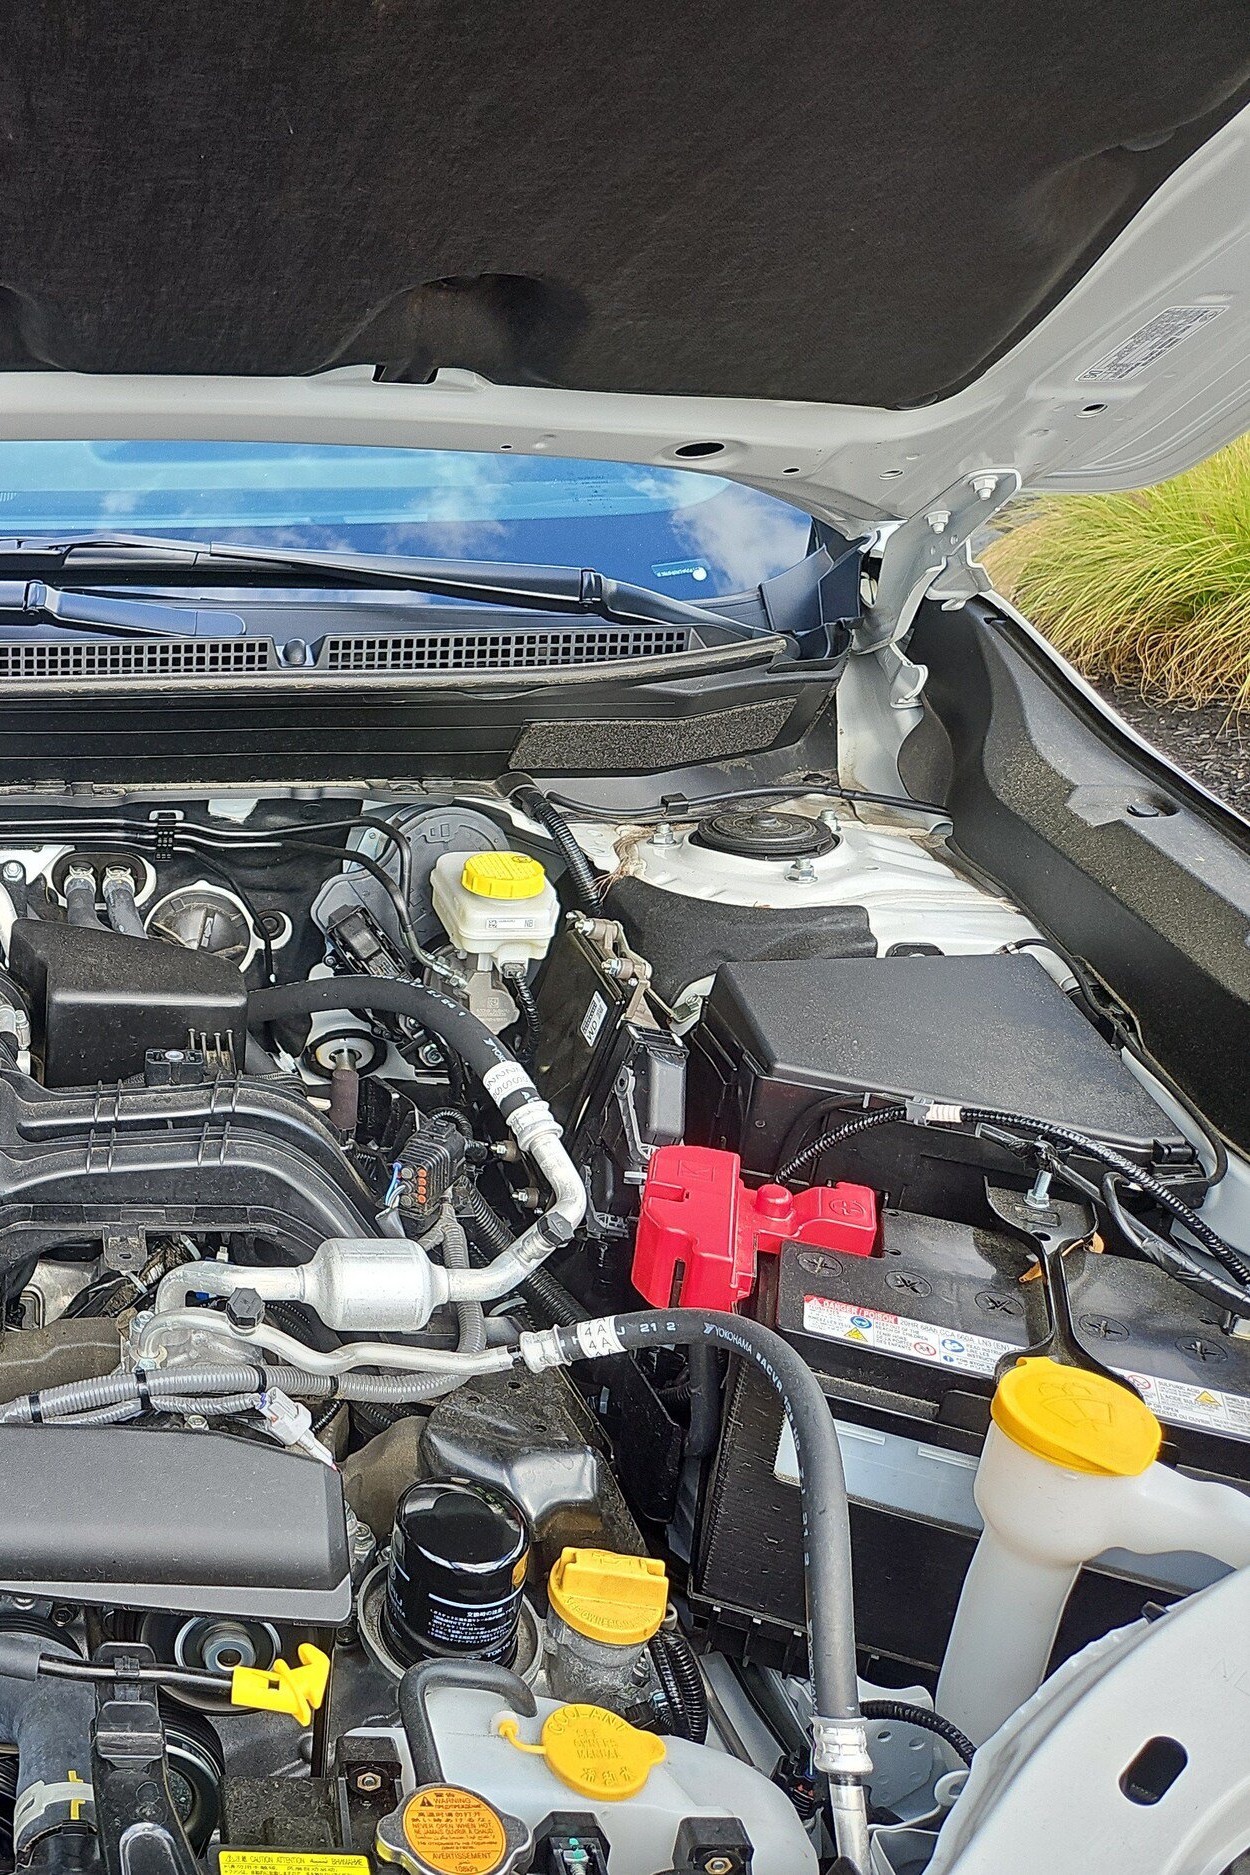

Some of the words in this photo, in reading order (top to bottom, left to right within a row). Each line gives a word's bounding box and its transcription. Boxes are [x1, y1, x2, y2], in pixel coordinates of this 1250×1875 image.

[823, 1301, 858, 1316] DANGER
[862, 1309, 895, 1323] POISON
[666, 1321, 676, 1331] 2
[715, 1325, 752, 1354] YOKOHAMA
[548, 1706, 629, 1734] COOLANT
